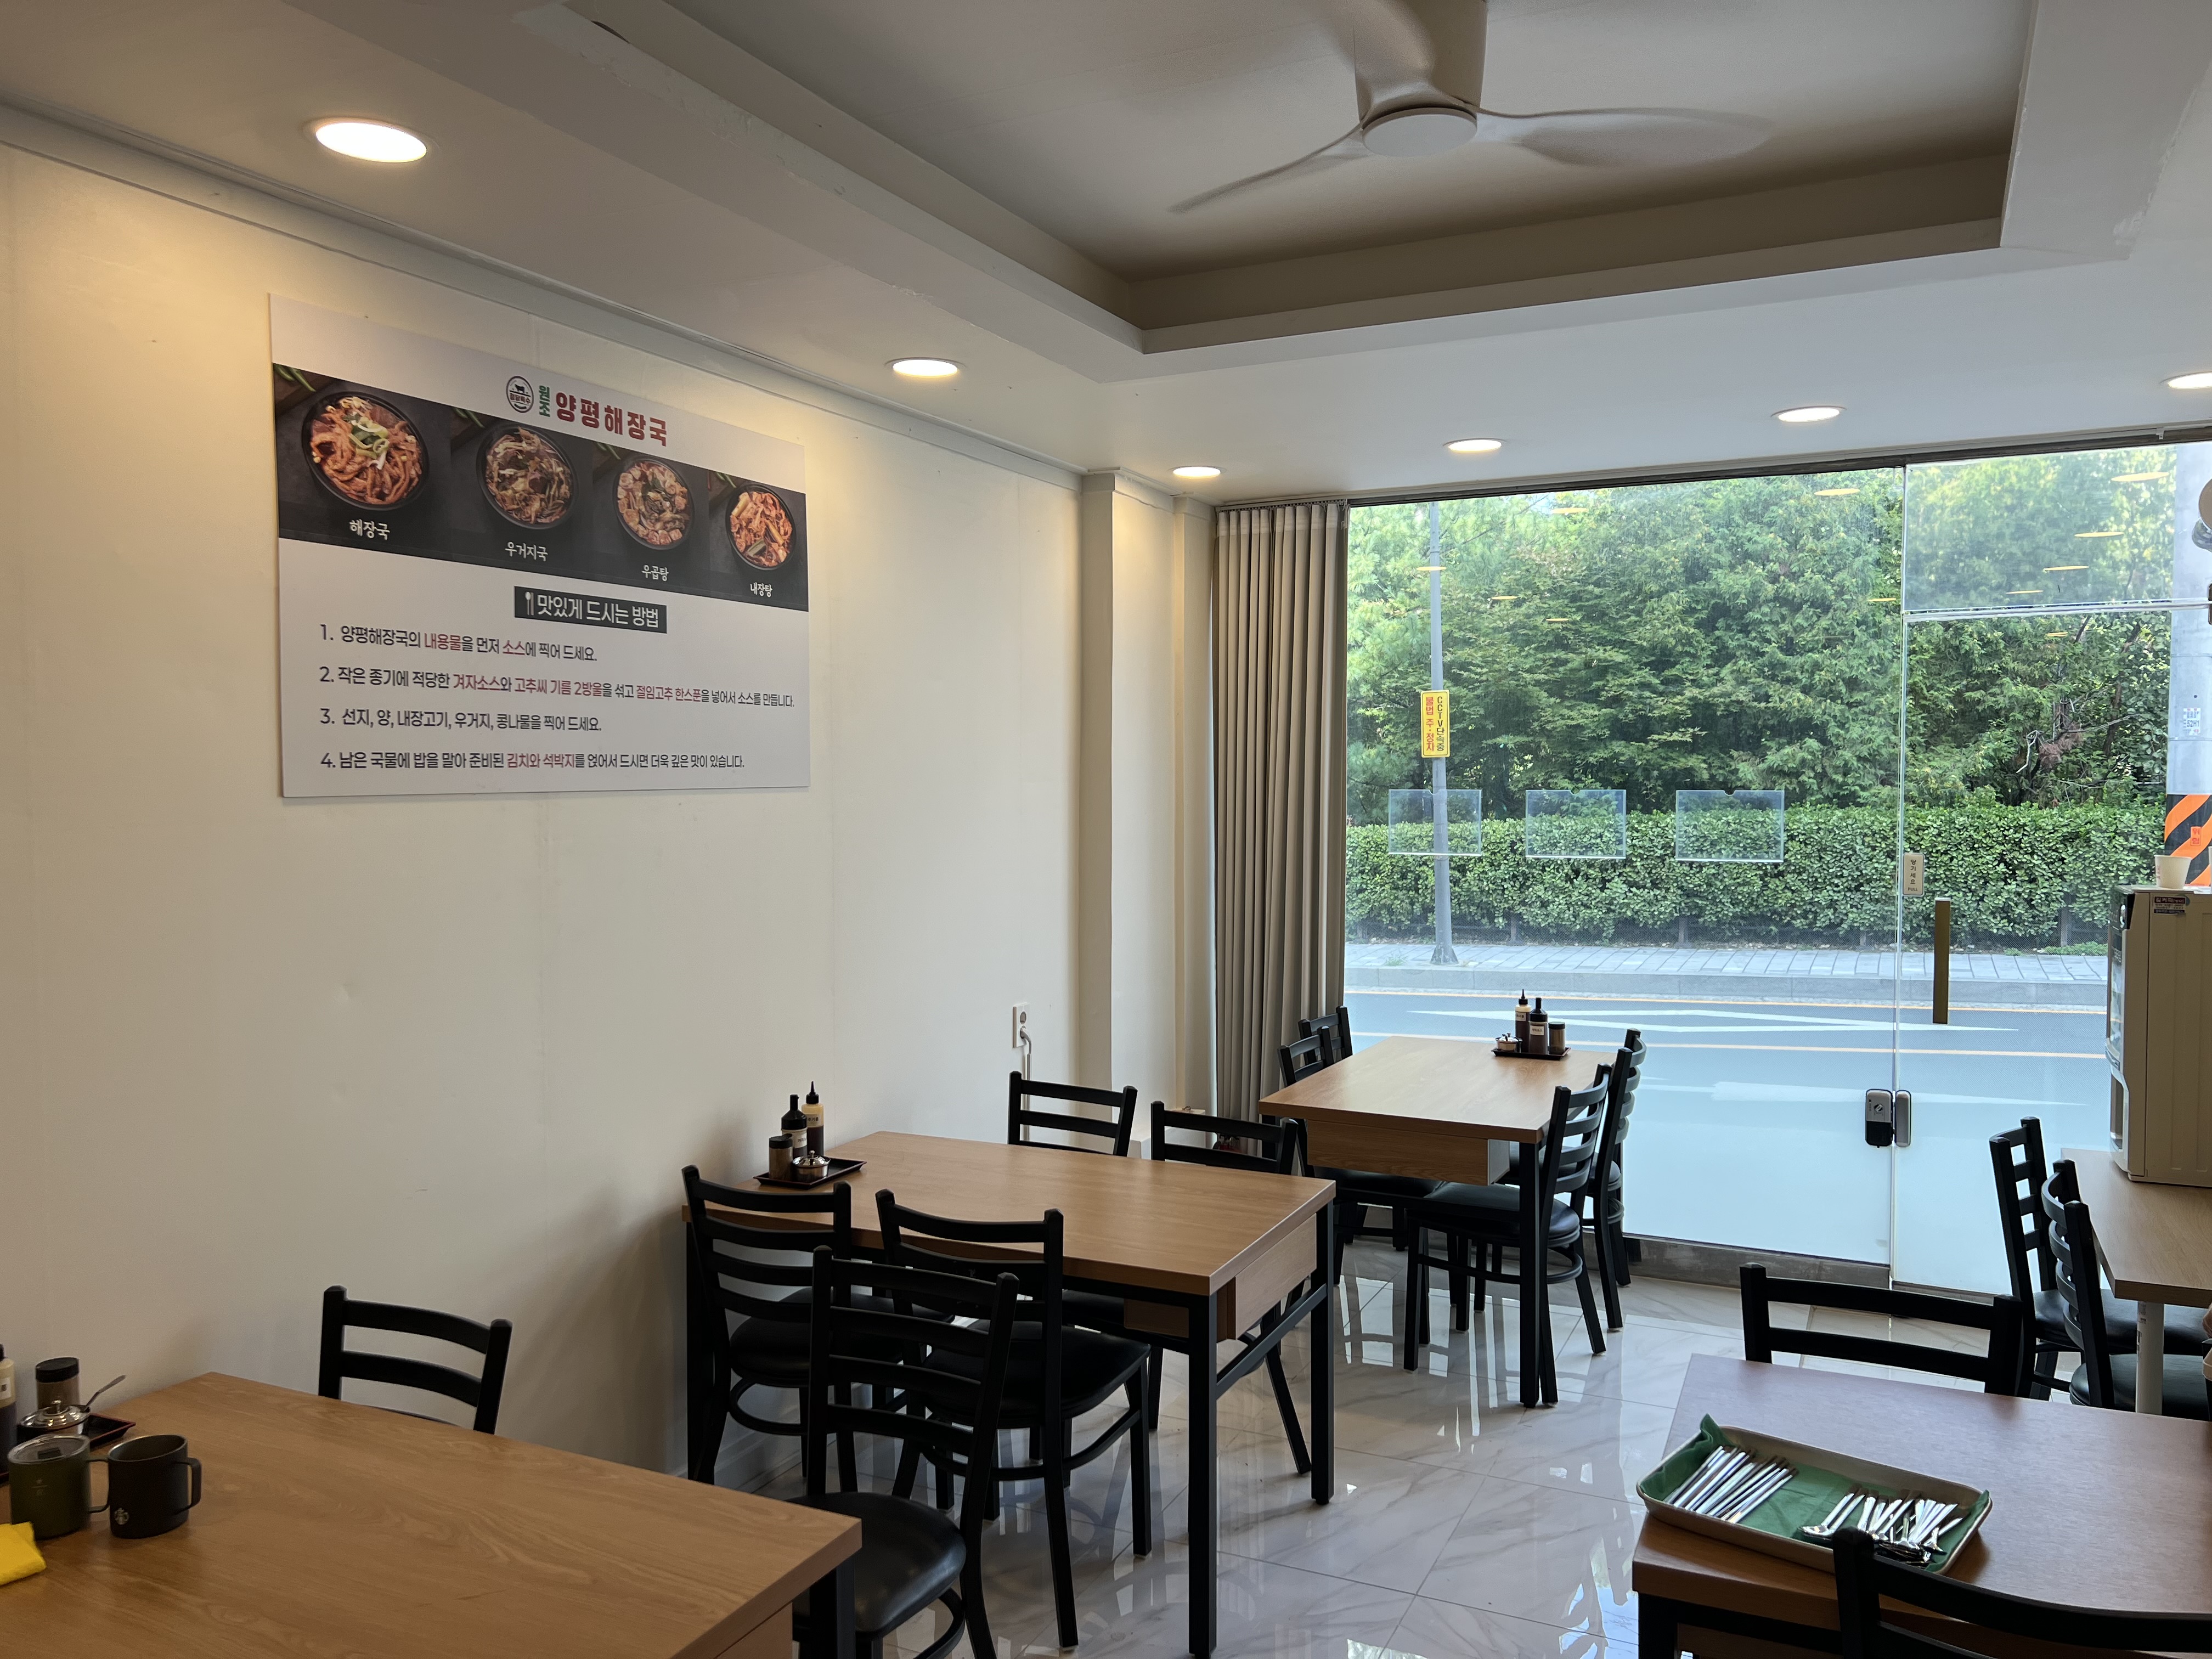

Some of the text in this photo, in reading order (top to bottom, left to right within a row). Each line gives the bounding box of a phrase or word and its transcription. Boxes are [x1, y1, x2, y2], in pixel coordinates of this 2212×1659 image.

[539, 385, 667, 447] 원조 양평해장국
[349, 519, 390, 540] 해장국
[505, 541, 549, 562] 우거지국
[641, 564, 669, 582] 우곱탕
[750, 582, 773, 597] 내장탕
[537, 593, 659, 628] 맛있게 드시는 방법
[320, 624, 597, 661] 1. 양평해장국의 내용물을 먼저 소스에 찍어 드세요.
[319, 666, 795, 708] 2. 작은 종기에 적당한 겨자소스와 고추씨 기름 2방울을 섞고 절임고추 한스푼을 넣어서 소스를 만듭니다.
[1426, 696, 1434, 715] 불법
[320, 708, 602, 731] 3. 선지, 양, 내장고기, 우거지, 콩나물을 찍어 드세요.
[1436, 696, 1444, 751] CCTV단속중
[320, 752, 745, 769] 4. 남은 국물에 밥을 말아 준비된 김치와 석박지를 얹어서 드시면 더욱 깊은 맛이 있습니다.
[2192, 828, 2200, 845] 위험
